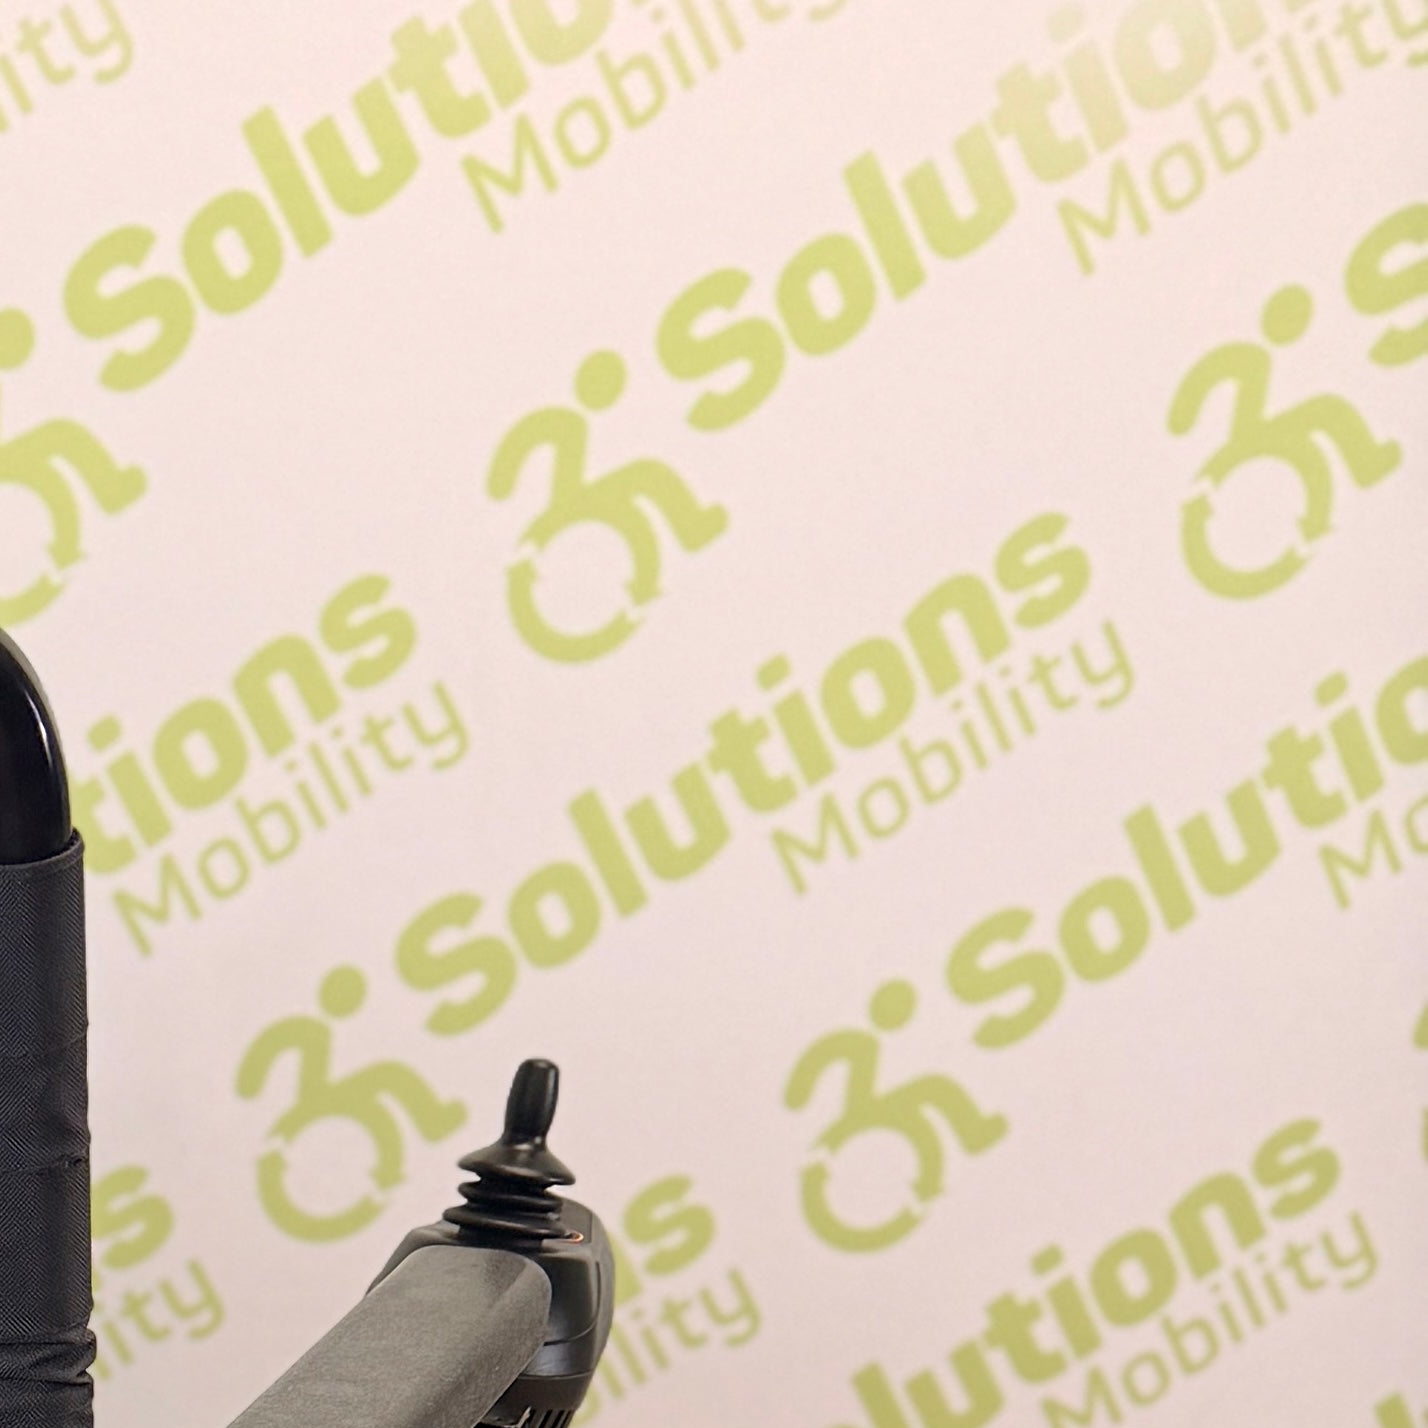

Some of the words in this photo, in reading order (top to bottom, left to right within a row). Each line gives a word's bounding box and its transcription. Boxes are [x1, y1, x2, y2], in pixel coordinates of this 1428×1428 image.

[112, 682, 469, 955] Mobility
[393, 512, 1092, 1038] Solutions
[771, 621, 1134, 894] Mobility
